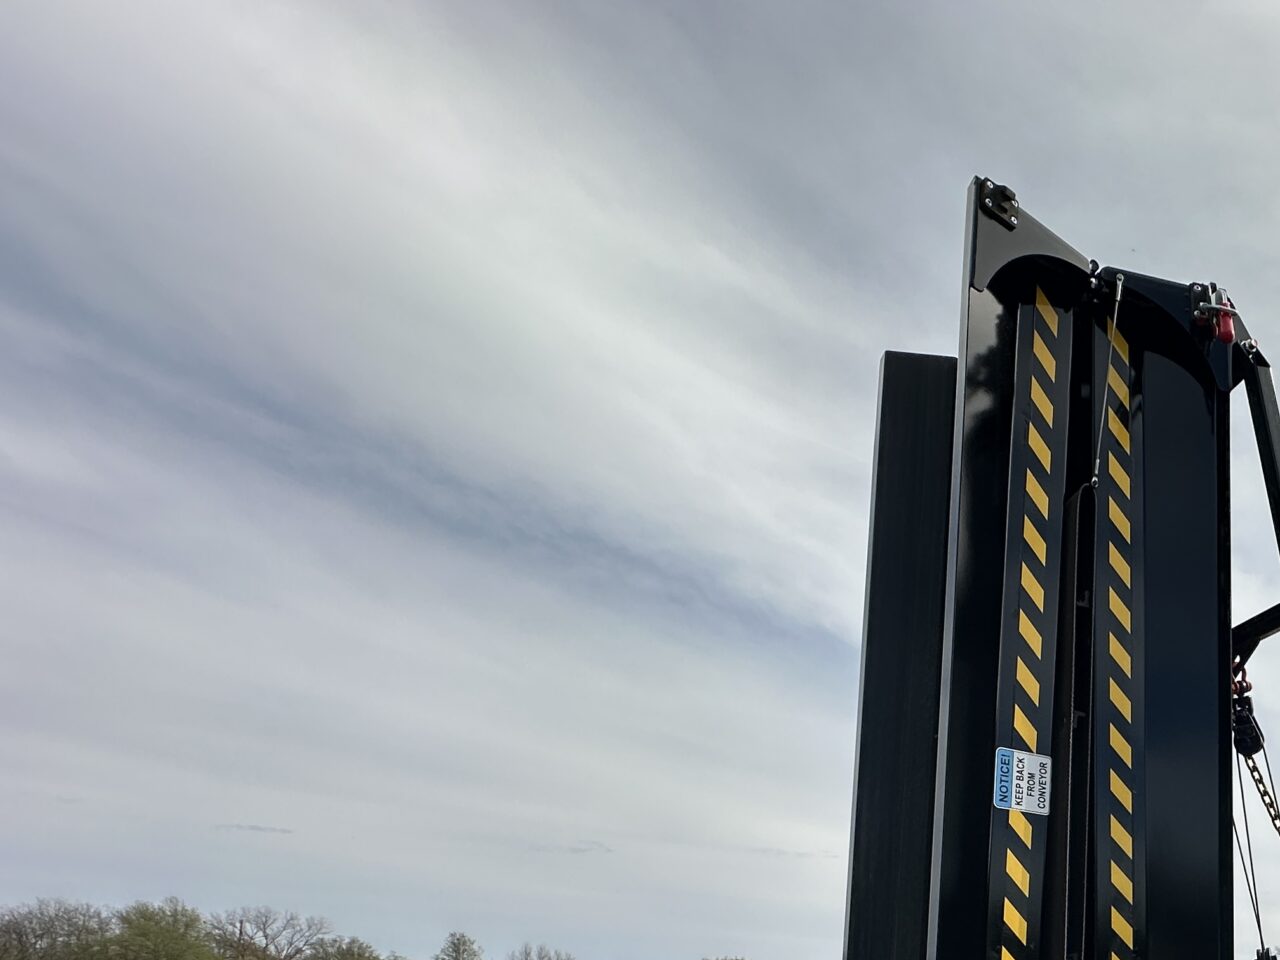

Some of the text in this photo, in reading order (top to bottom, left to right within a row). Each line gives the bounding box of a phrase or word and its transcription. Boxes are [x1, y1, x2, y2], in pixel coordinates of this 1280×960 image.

[998, 754, 1010, 803] NOTICE!
[1014, 757, 1026, 807] KEEP BACK
[1026, 772, 1036, 798] FROM
[1037, 761, 1048, 809] CONVEYOR
